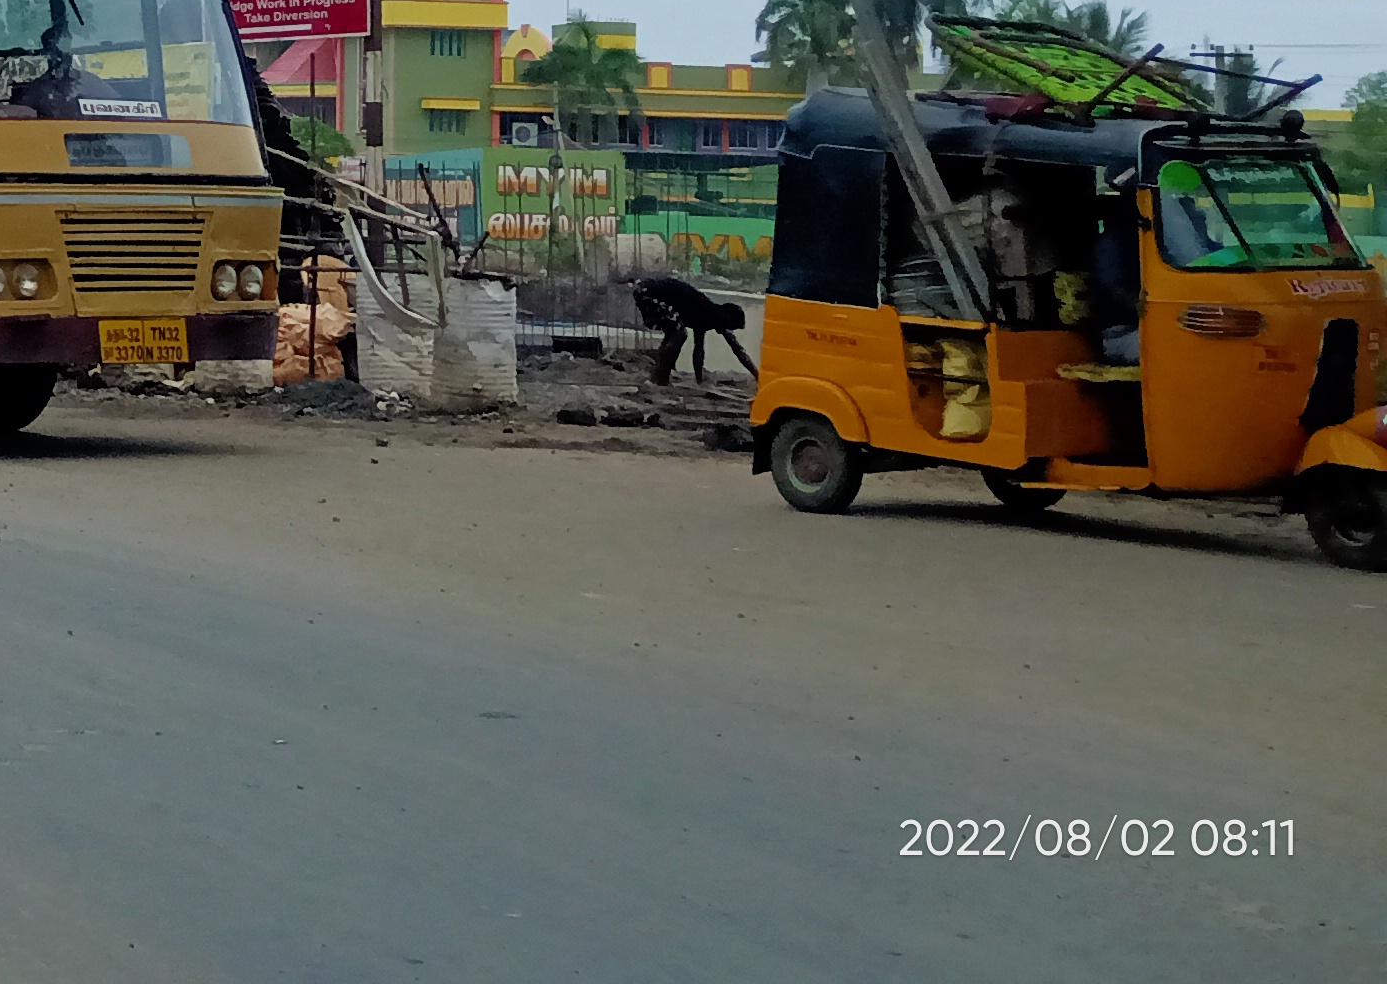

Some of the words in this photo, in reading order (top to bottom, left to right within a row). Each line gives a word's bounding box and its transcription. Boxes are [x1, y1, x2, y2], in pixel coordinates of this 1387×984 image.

[244, 13, 270, 23] Take
[273, 10, 329, 22] Diversion
[82, 101, 160, 115] புவனகிரி
[156, 346, 183, 361] 3370
